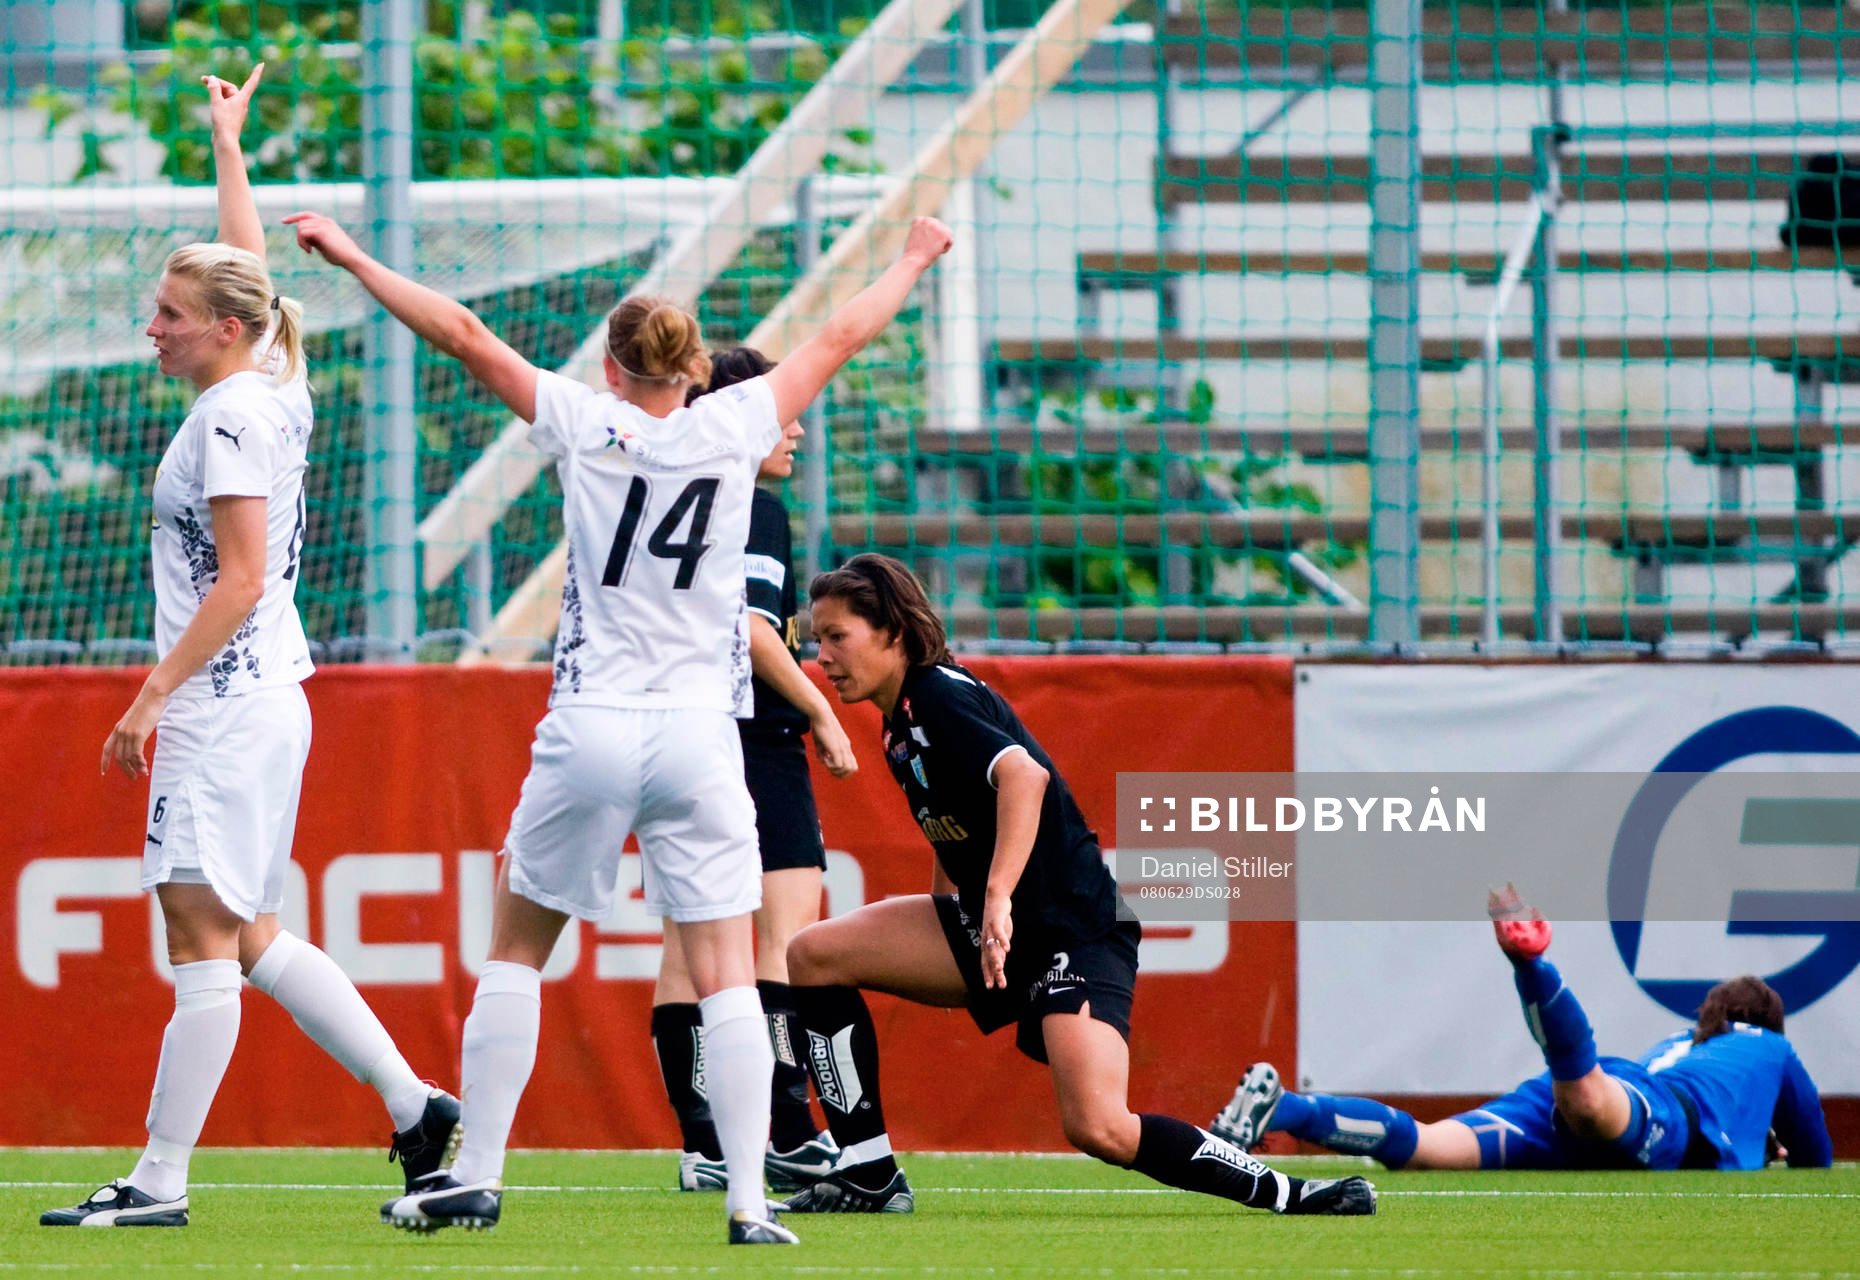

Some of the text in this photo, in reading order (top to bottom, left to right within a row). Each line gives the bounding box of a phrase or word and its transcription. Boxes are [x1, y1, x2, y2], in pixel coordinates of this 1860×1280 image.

[601, 472, 724, 590] 14
[152, 796, 167, 824] 6
[811, 1035, 840, 1106] ARROW
[1202, 1141, 1267, 1173] ARROW
